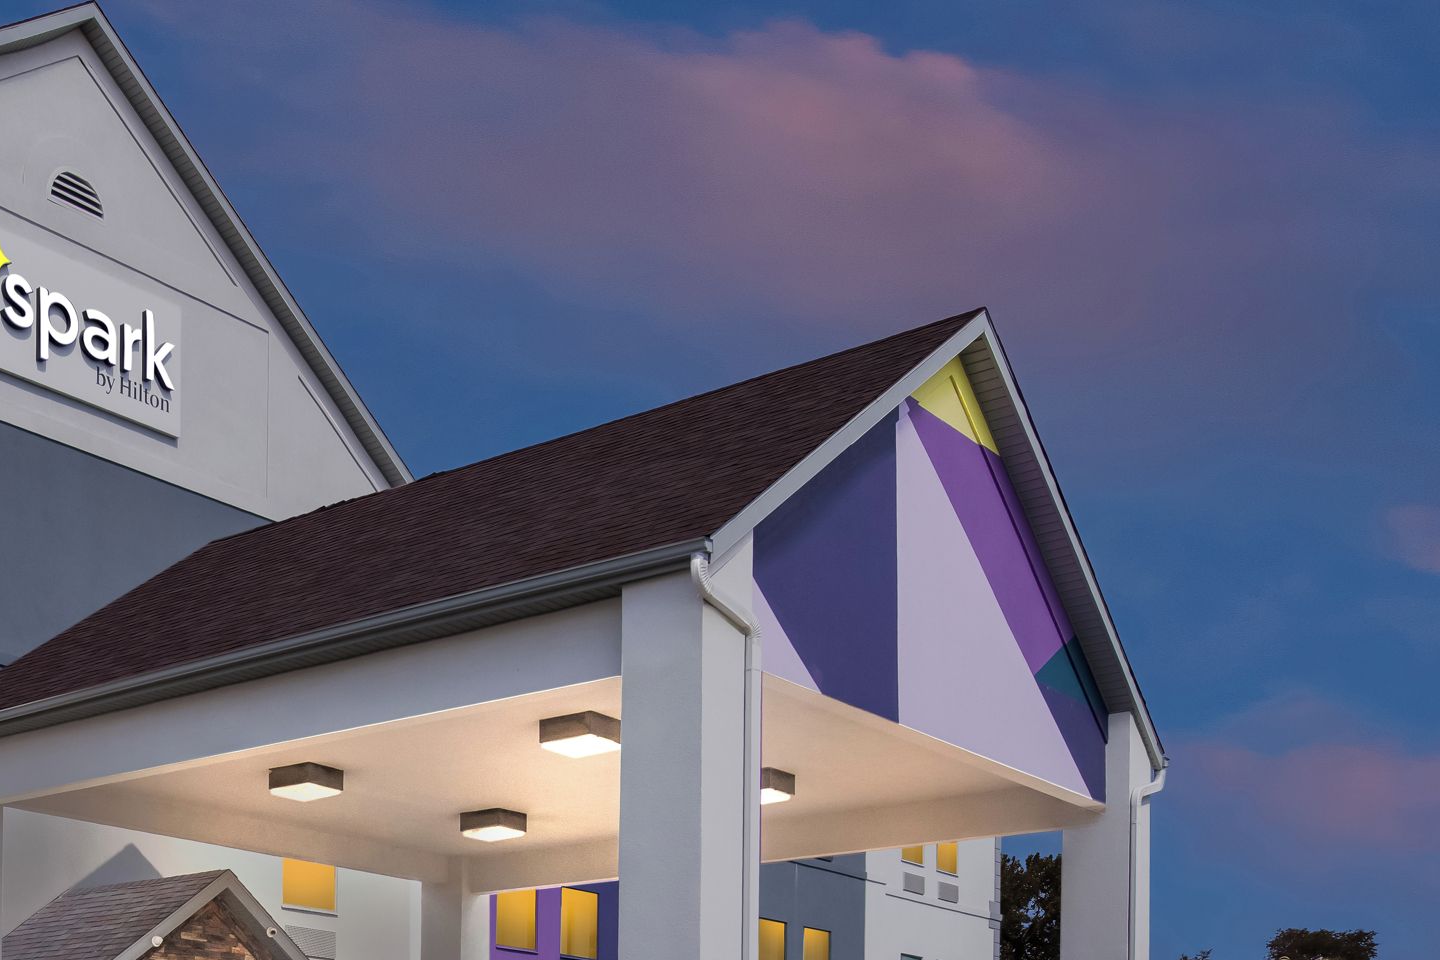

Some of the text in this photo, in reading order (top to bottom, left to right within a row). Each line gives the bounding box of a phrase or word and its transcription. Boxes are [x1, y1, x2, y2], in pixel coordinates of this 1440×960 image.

[0, 274, 175, 391] spark
[96, 366, 170, 413] by Hilton
